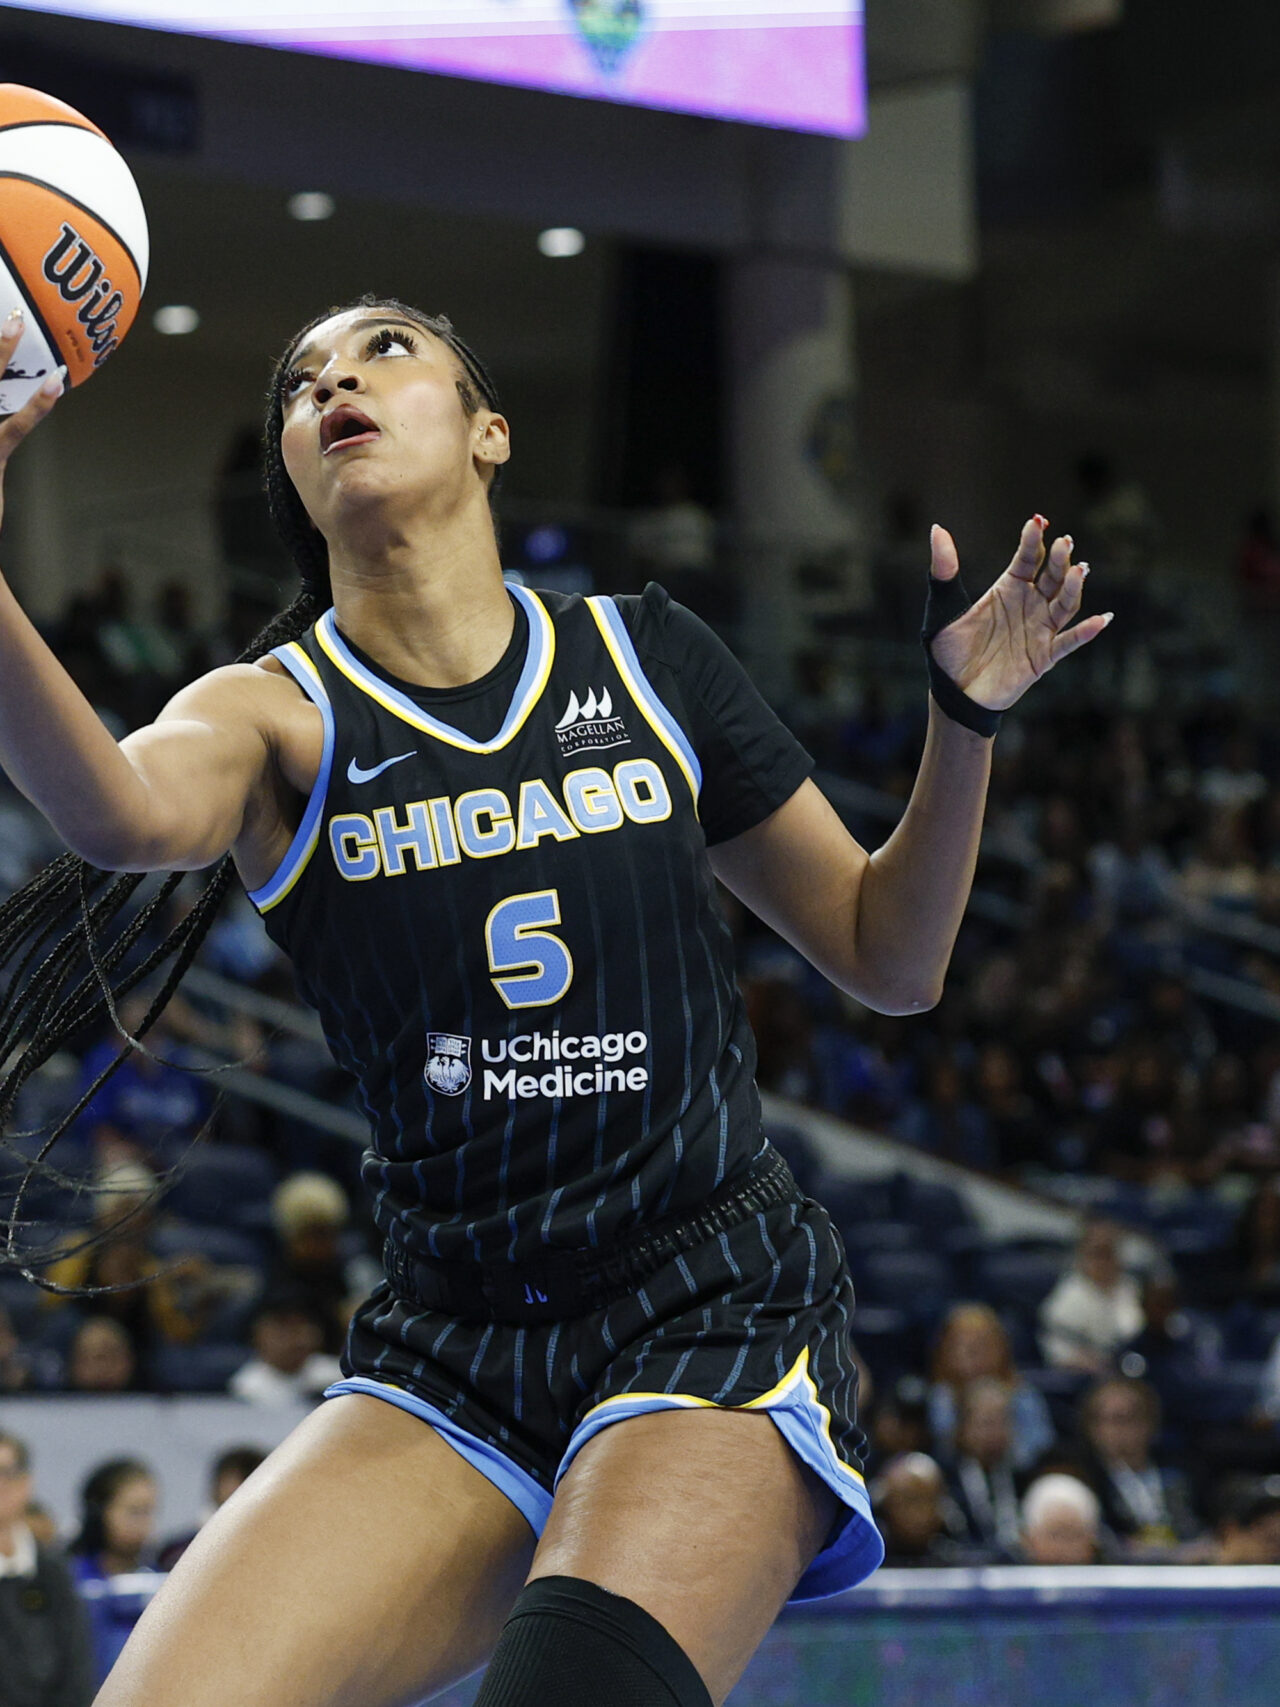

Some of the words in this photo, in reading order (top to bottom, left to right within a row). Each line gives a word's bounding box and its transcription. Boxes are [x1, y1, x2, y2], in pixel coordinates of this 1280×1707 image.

[42, 221, 123, 368] Wilso
[556, 720, 625, 743] MAGELLAN
[328, 758, 673, 882] CHICAGO
[484, 888, 574, 1010] 5
[481, 1029, 648, 1063] UChicago
[482, 1063, 649, 1101] Medicine
